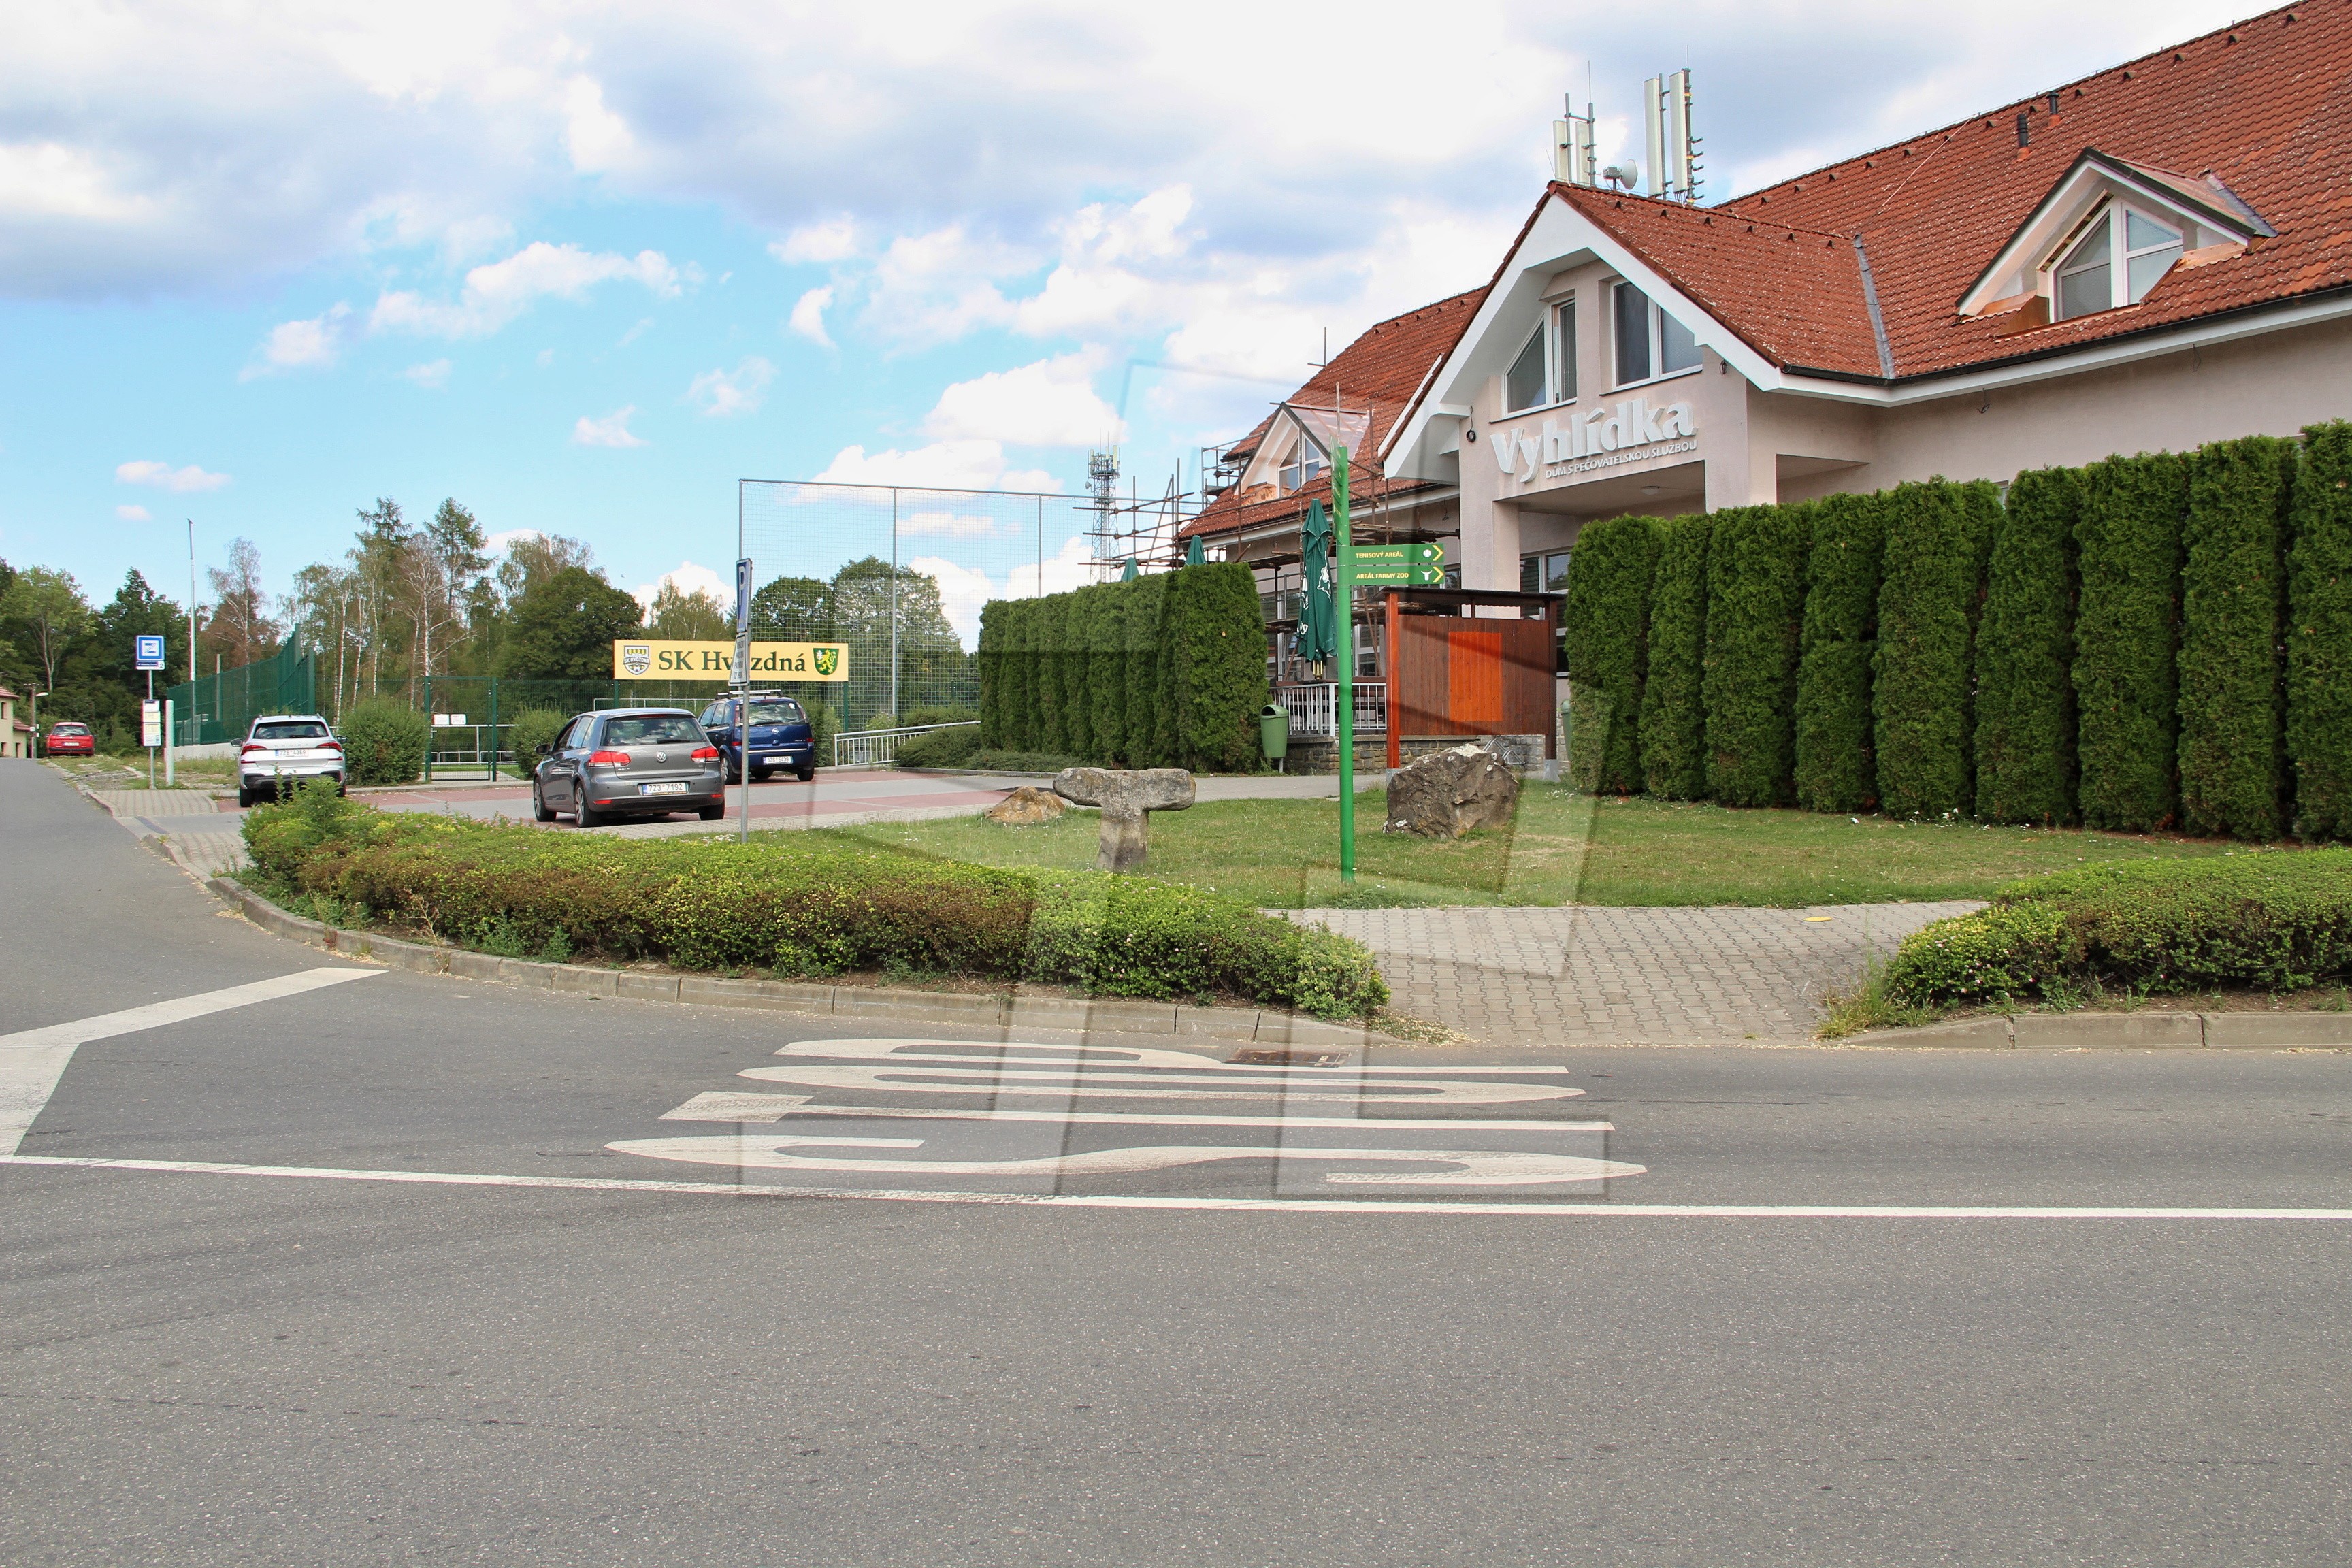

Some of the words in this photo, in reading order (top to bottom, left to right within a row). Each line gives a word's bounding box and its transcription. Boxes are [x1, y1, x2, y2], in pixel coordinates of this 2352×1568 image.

[1490, 397, 1699, 483] Vyhlídka
[1567, 465, 1574, 474] S
[1574, 449, 1650, 473] PEČOVATELSKOU
[1651, 440, 1698, 458] SLUŽBOU
[1355, 551, 1384, 559] TENISOVÝ
[658, 650, 695, 671] SK
[701, 651, 807, 672] Hvzdná
[604, 1038, 1648, 1185] STOP
